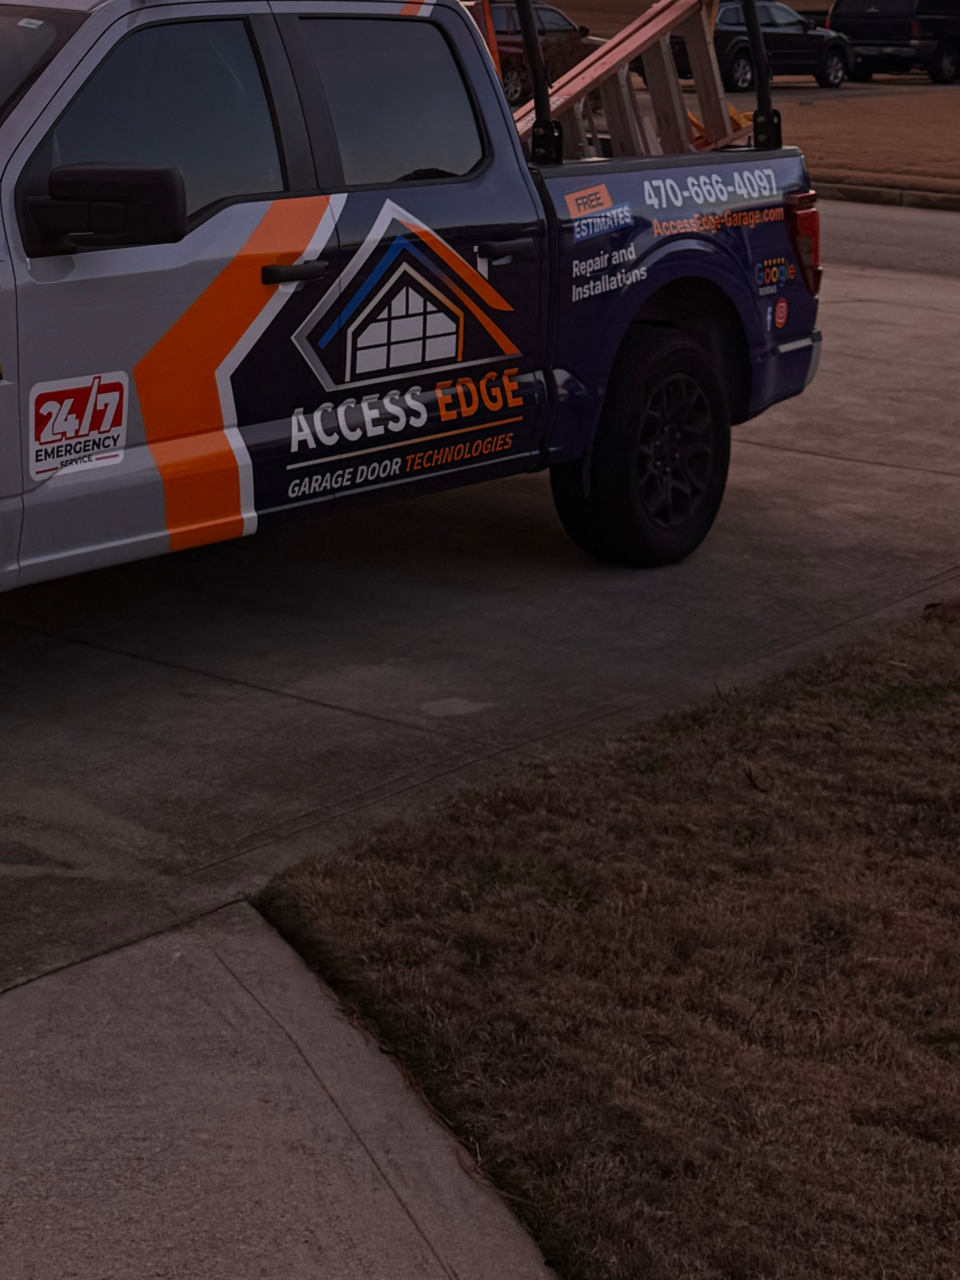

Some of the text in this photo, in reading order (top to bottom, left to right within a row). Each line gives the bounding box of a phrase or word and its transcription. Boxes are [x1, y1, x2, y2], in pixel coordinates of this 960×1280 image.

[574, 191, 603, 213] FREE
[643, 168, 778, 210] 470-666-4097
[573, 205, 631, 240] ESTIMATES
[652, 206, 785, 238] AccessEdge-Garage.com
[572, 243, 636, 278] Repair and
[755, 260, 796, 287] Google
[572, 264, 648, 303] Installations
[38, 376, 121, 444] 24/7
[289, 367, 524, 453] ACCESS EDGE
[35, 434, 121, 463] EMERGENCY
[60, 455, 93, 469] SERVICE
[288, 432, 514, 499] GARAGE DOOR TECHNOLOGIES
